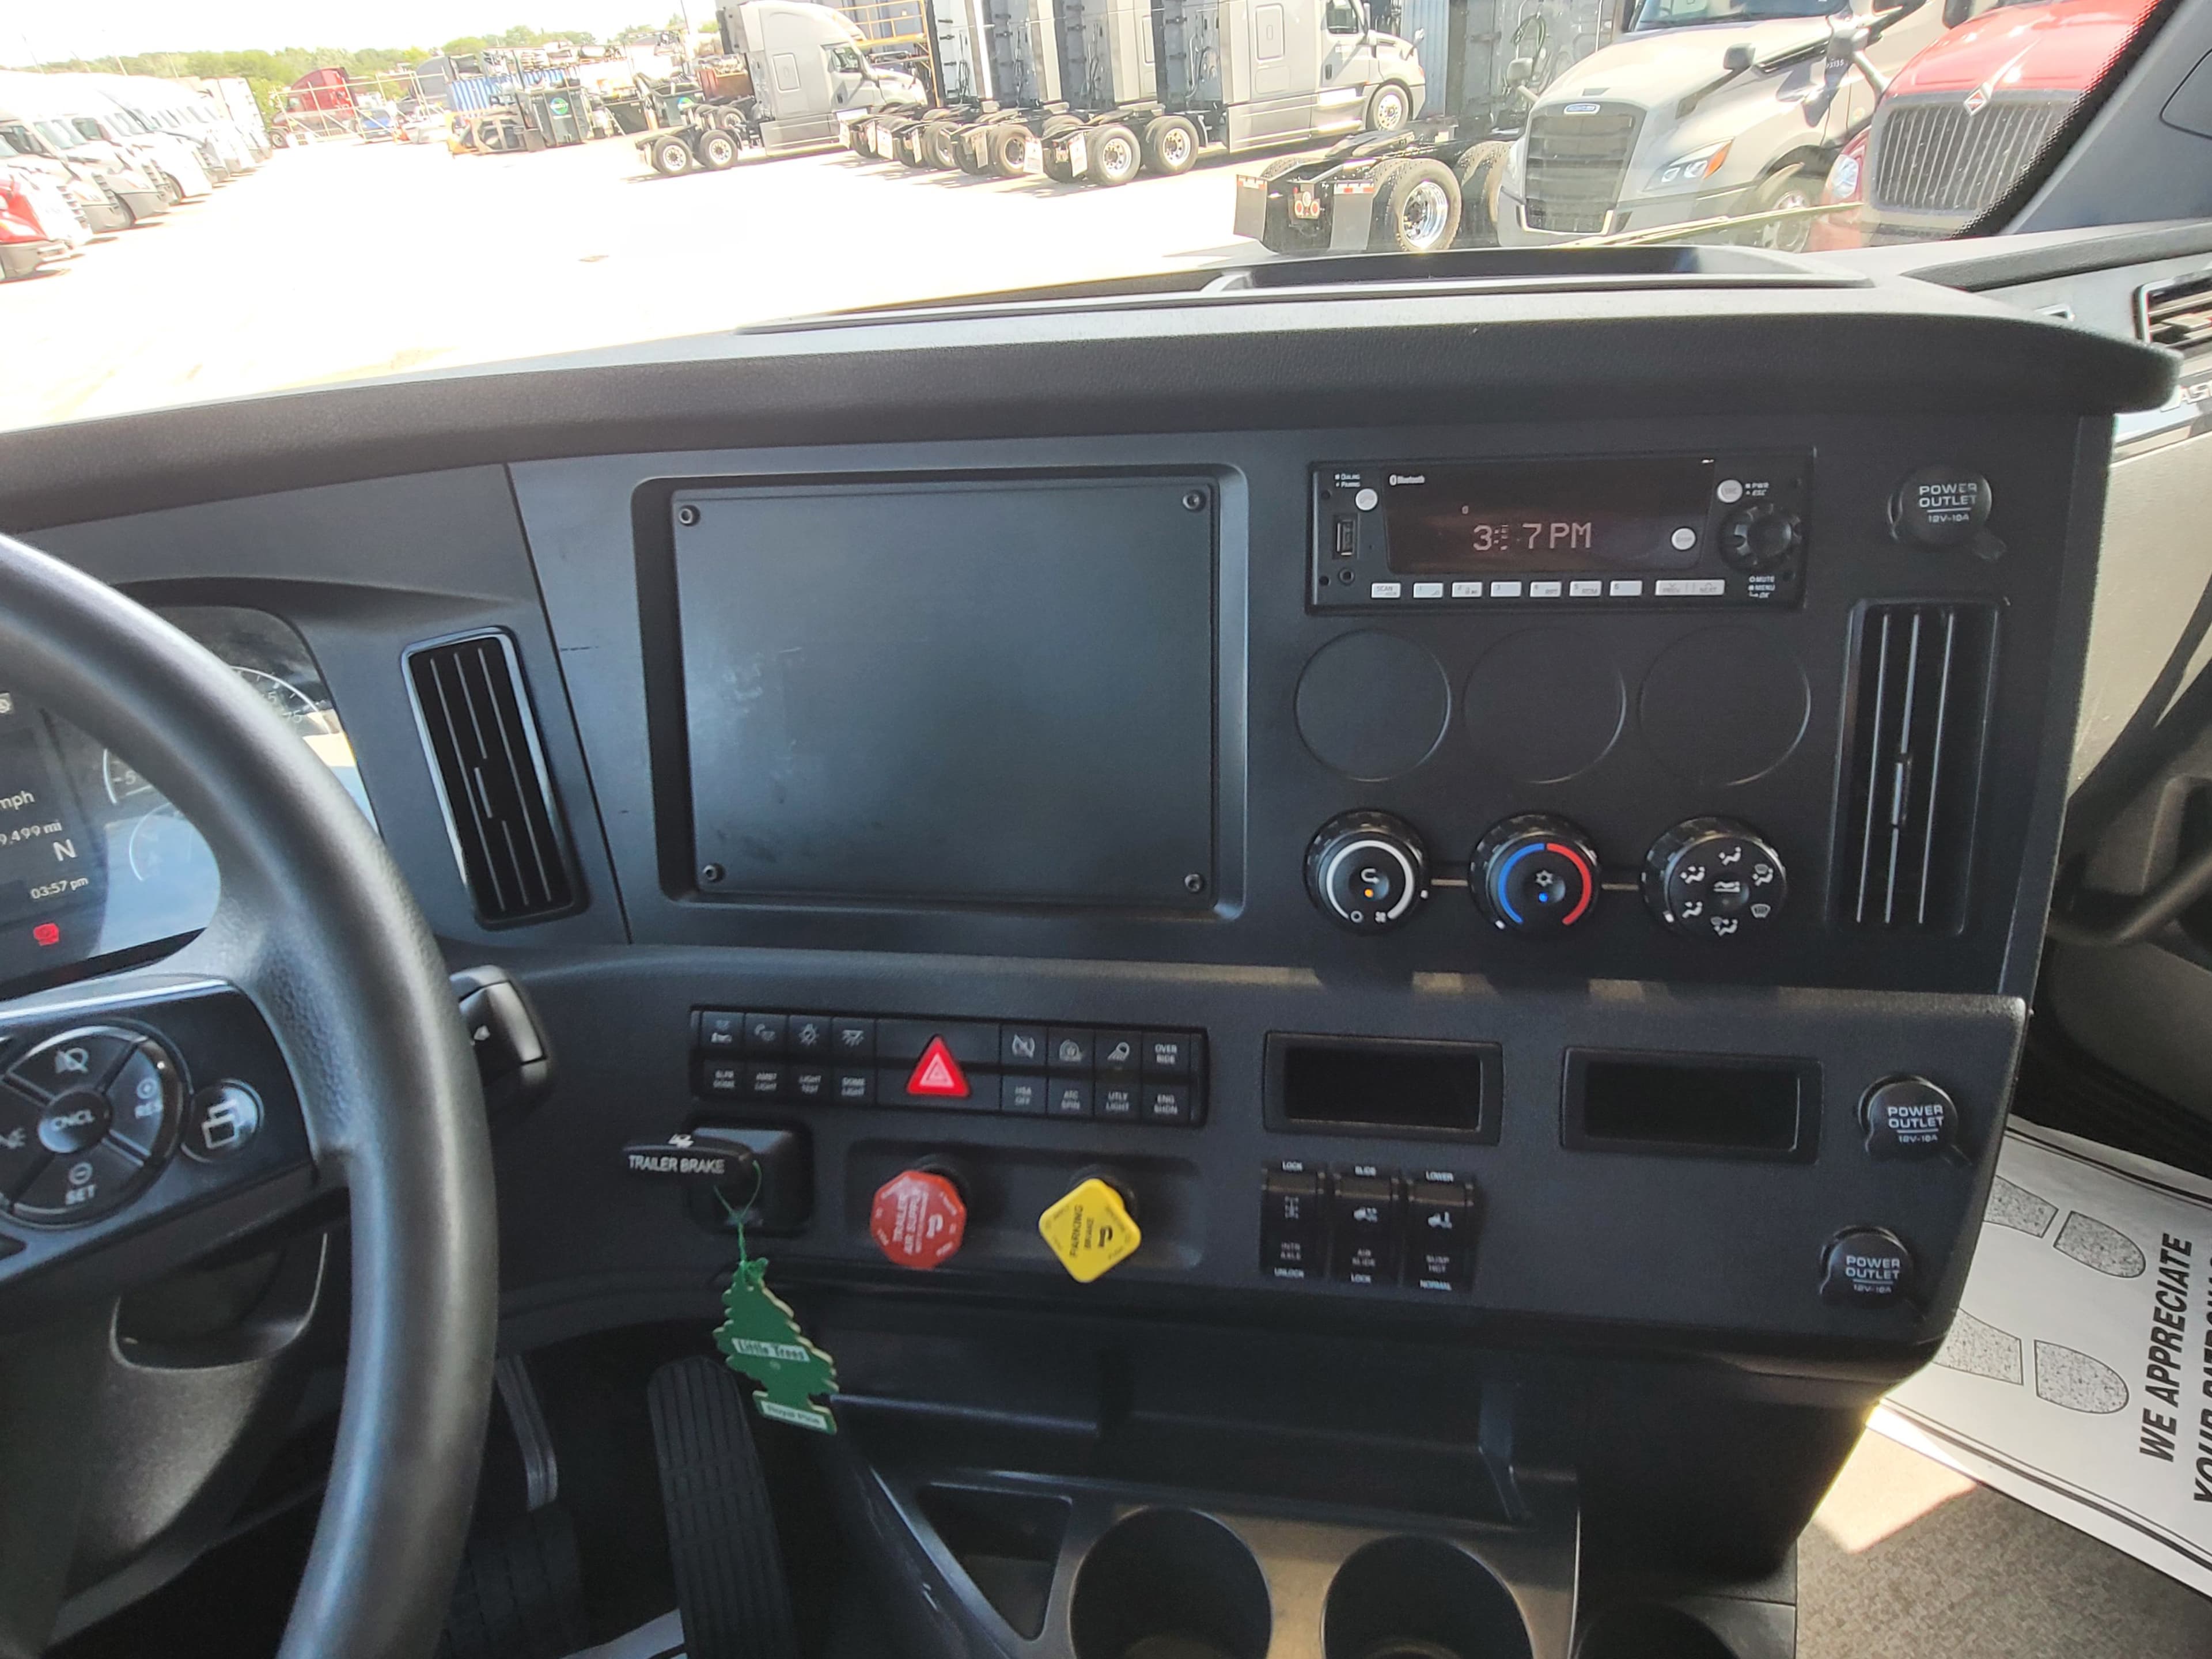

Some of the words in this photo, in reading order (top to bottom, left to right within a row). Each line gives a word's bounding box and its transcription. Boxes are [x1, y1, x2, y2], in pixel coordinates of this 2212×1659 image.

[1919, 482, 1978, 496] POWER
[1919, 495, 1977, 508] OUTLET
[1550, 522, 1592, 549] PM
[52, 839, 78, 862] N
[30, 879, 68, 899] 03:57
[70, 877, 89, 891] pm
[1154, 1044, 1177, 1054] OVER
[1887, 1104, 1944, 1117] POWER
[1888, 1116, 1945, 1128] OUTLET
[628, 1154, 678, 1173] TRAILER
[680, 1157, 725, 1175] BRAKE
[1282, 1161, 1304, 1172] LOCK
[1426, 1171, 1455, 1182] LOWER
[1846, 1255, 1901, 1268] POWER
[1845, 1267, 1901, 1279] OUTLET
[2145, 1233, 2192, 1408] APPRECIATE
[738, 1339, 770, 1355] Little
[772, 1343, 805, 1360] Trees
[2139, 1407, 2177, 1463] WE
